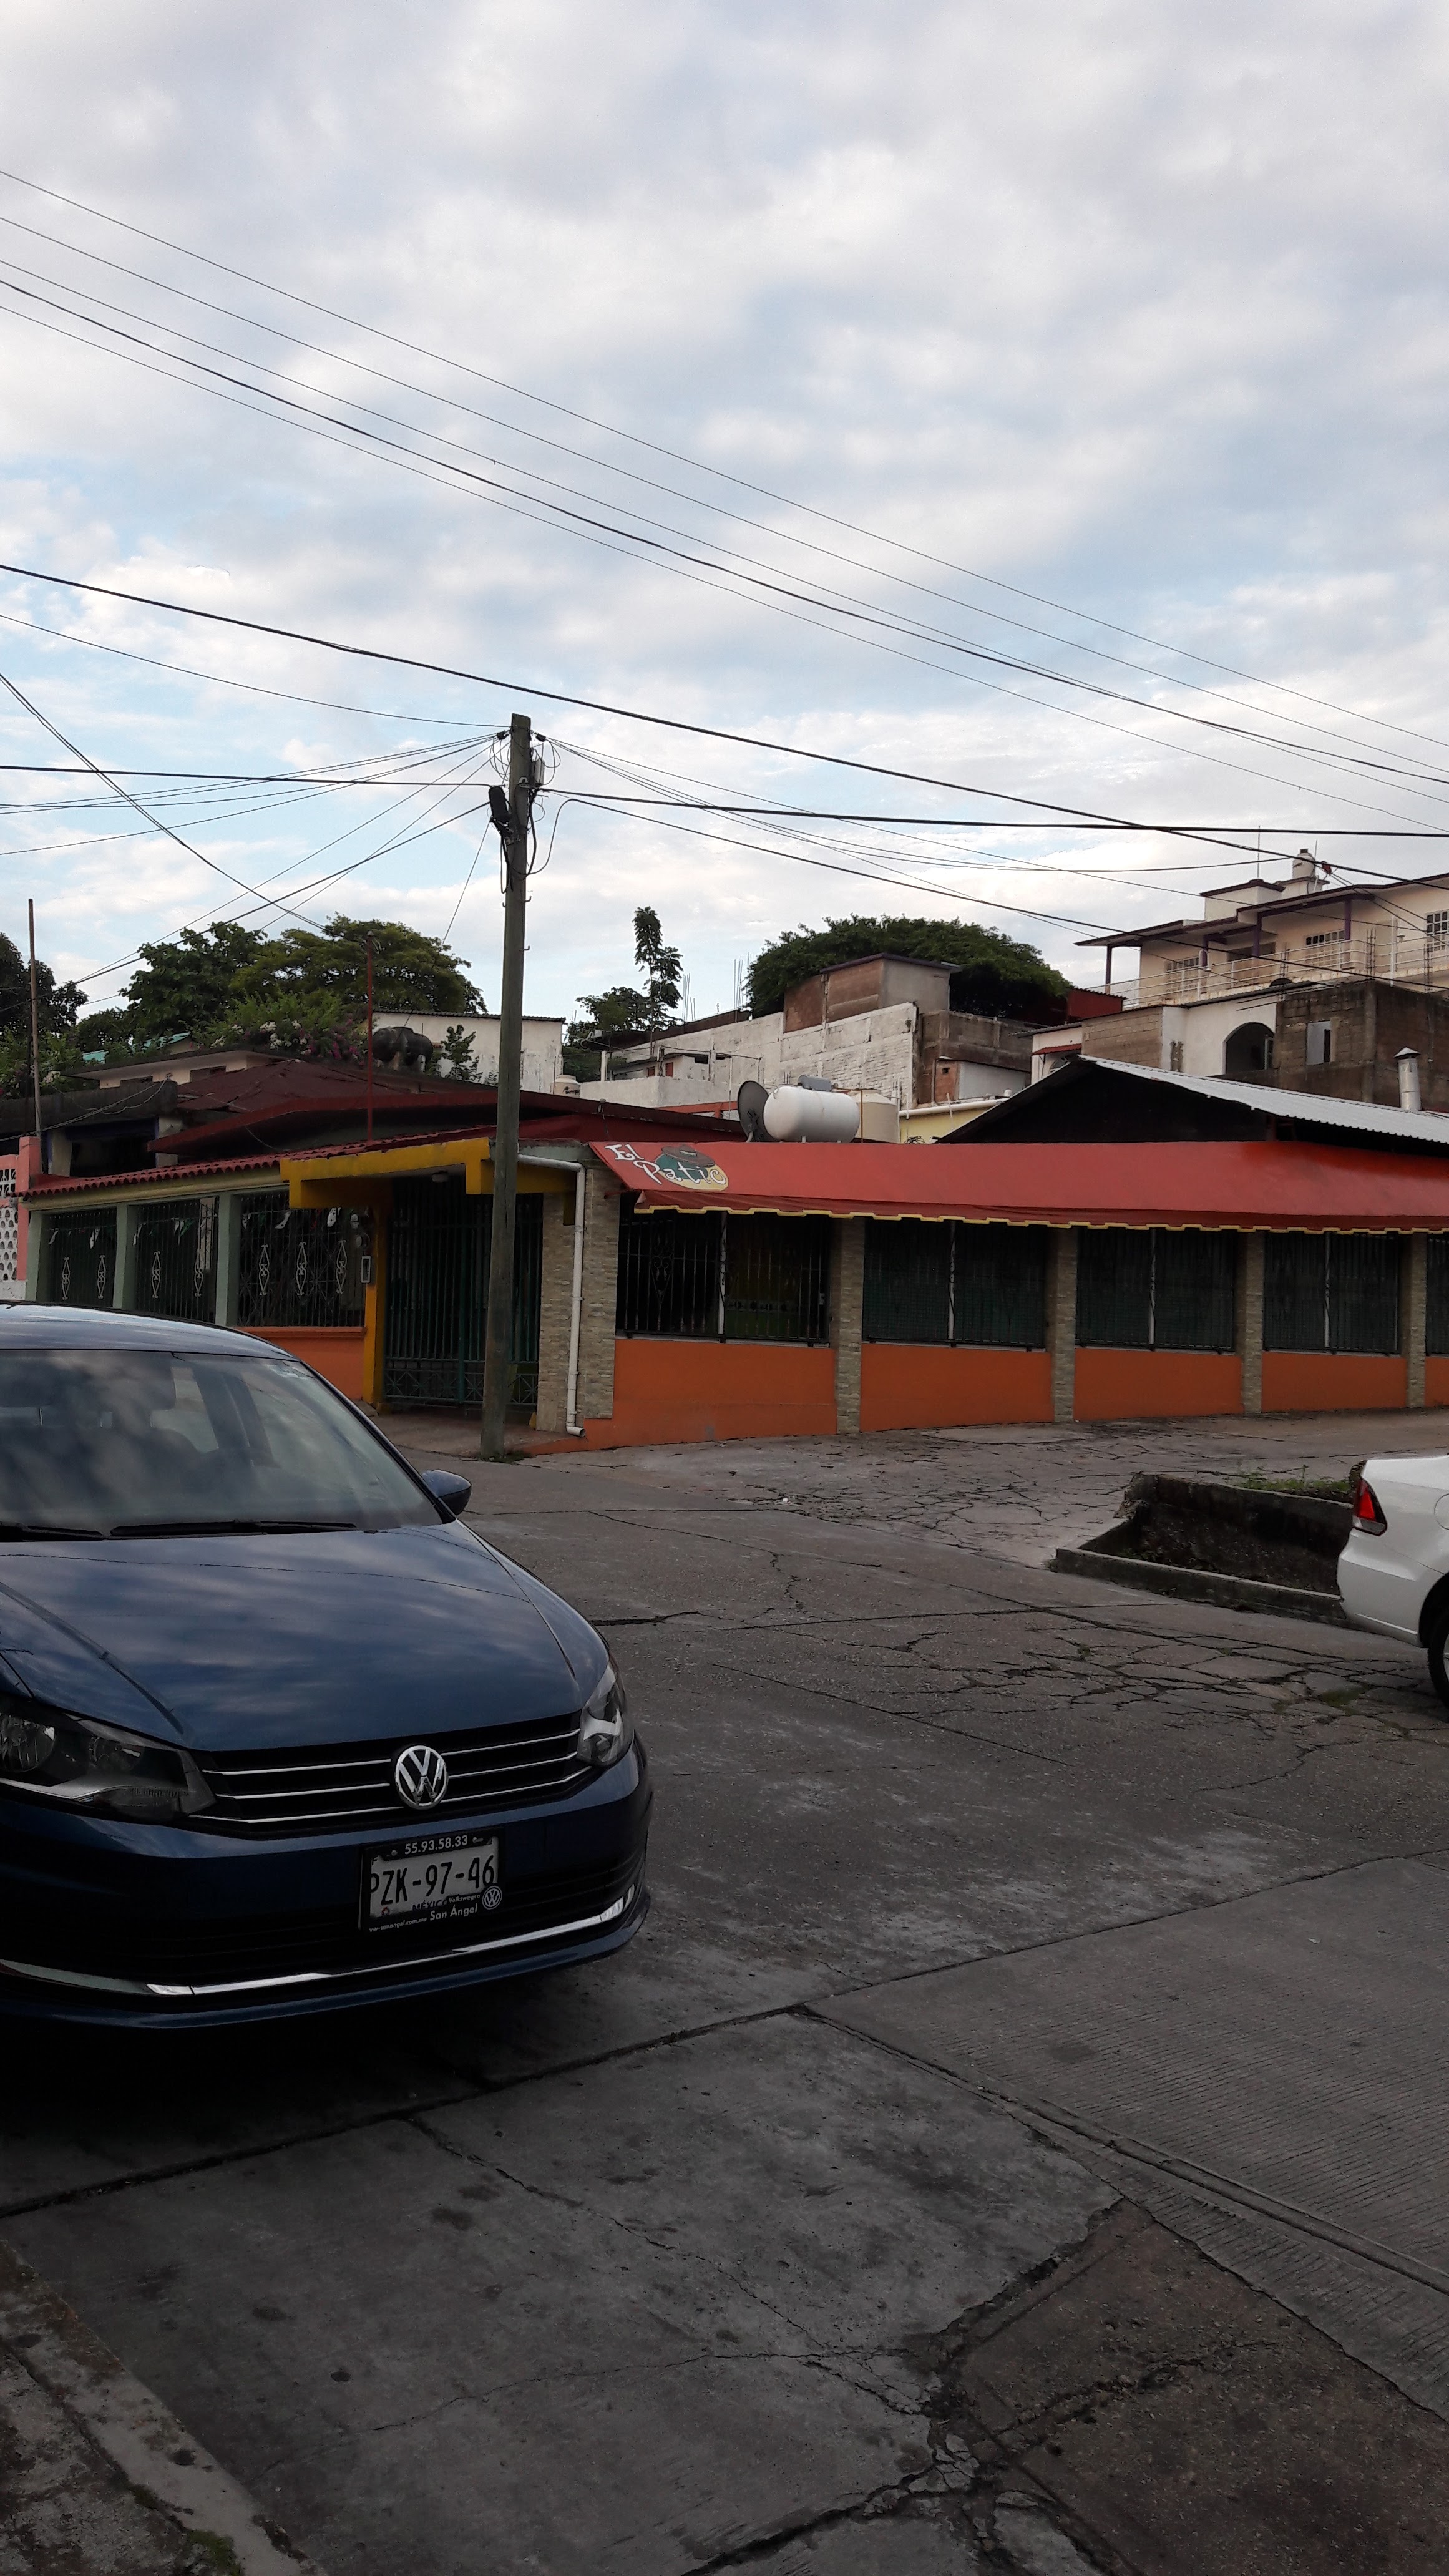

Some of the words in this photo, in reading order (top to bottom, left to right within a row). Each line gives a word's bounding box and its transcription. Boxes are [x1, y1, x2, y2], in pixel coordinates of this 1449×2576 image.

[605, 1143, 645, 1161] El
[404, 1834, 468, 1855] 55.93.58.33
[370, 1855, 494, 1906] PZK-97-46
[430, 1910, 447, 1921] San
[449, 1903, 478, 1918] Ángel
